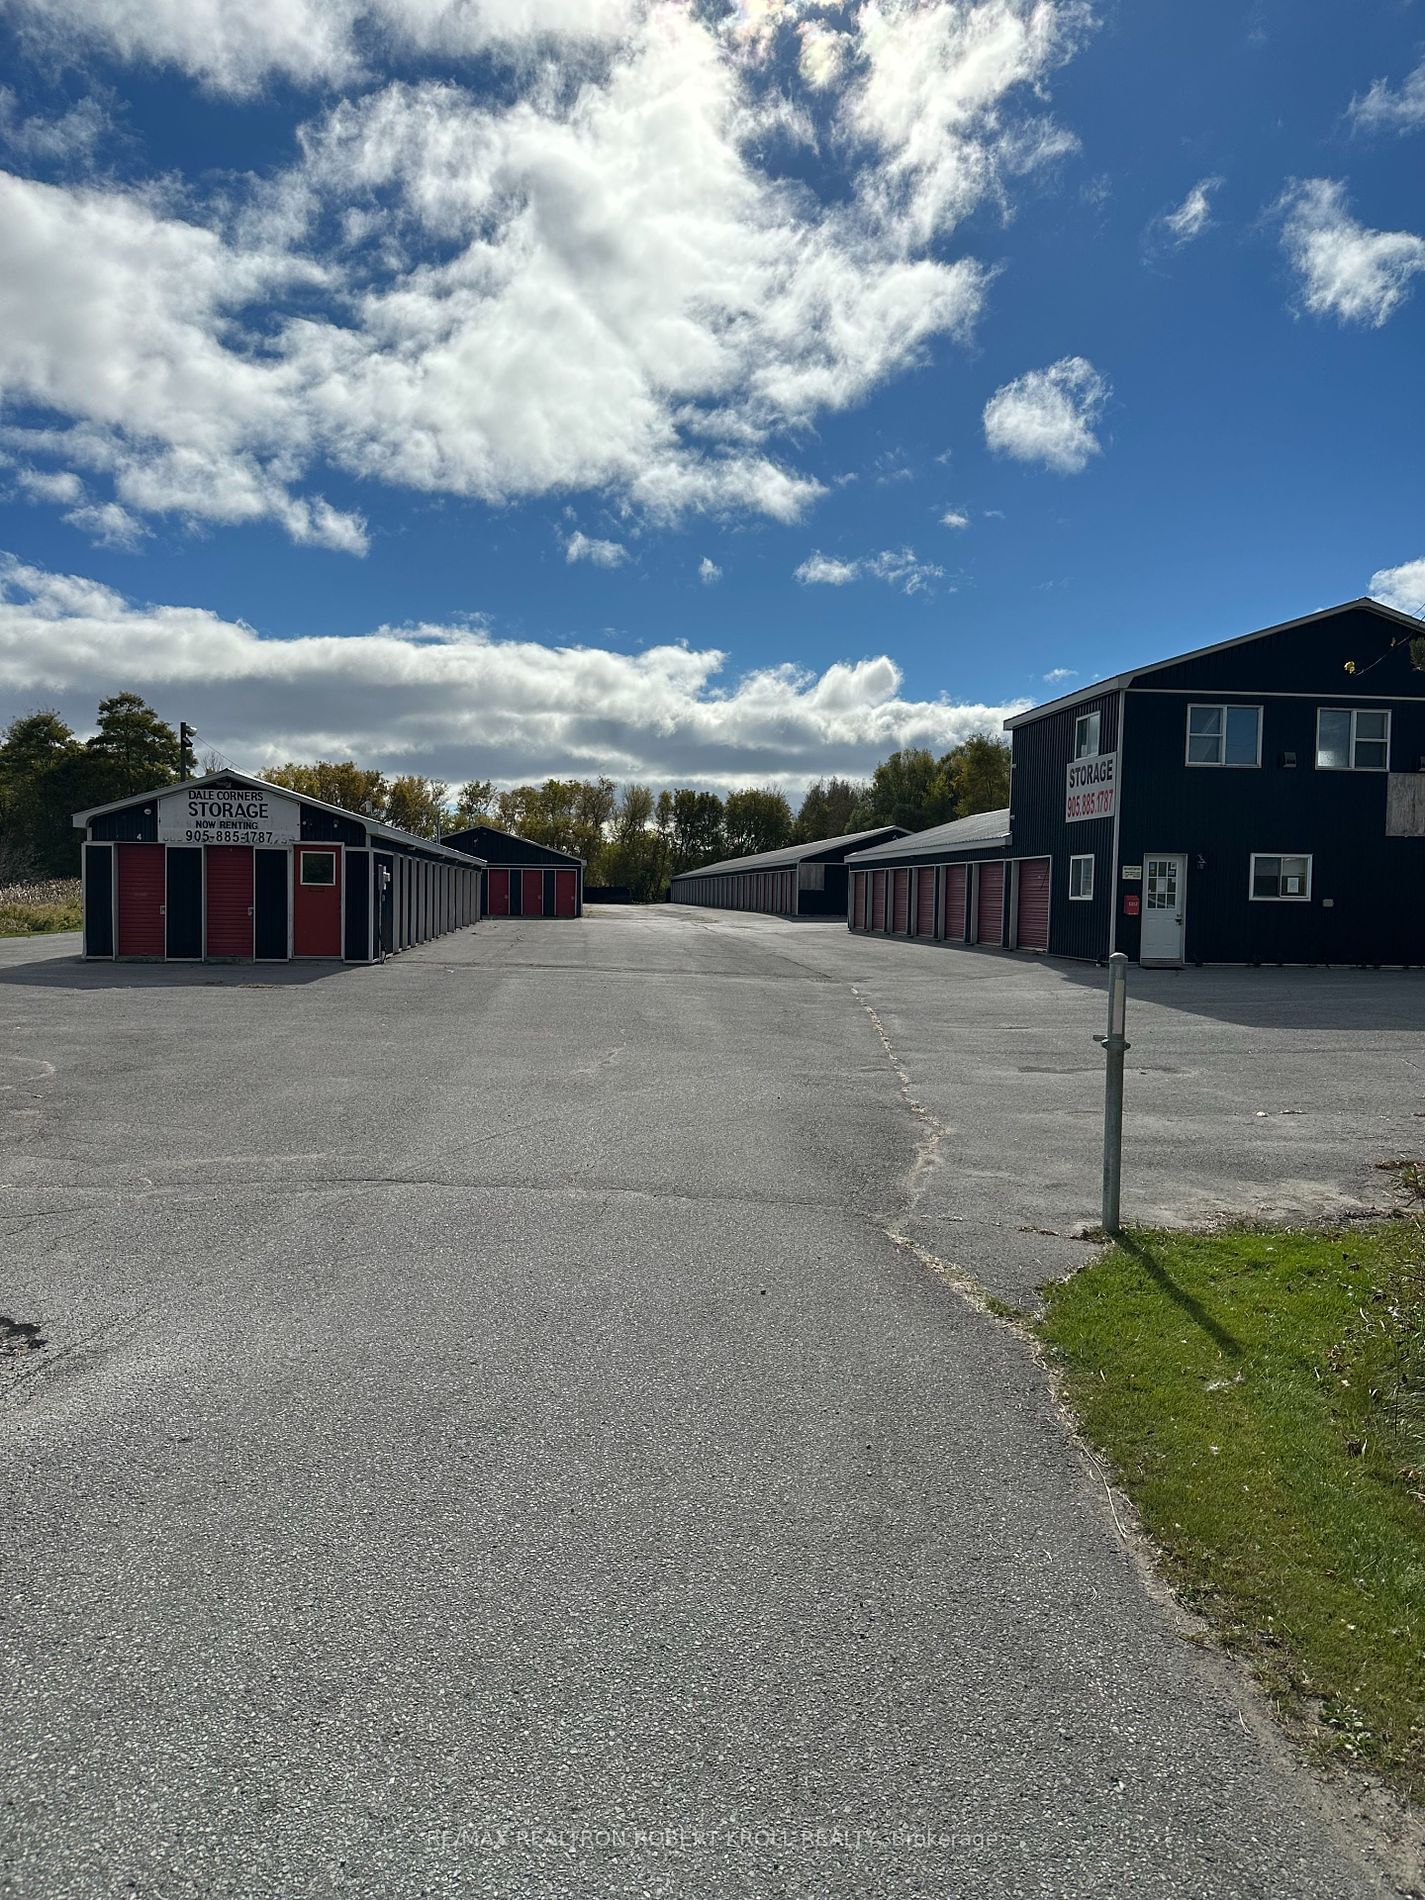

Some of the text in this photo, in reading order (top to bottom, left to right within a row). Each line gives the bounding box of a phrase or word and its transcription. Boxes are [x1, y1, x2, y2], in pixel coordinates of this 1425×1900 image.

[1069, 759, 1113, 789] STORAGE
[188, 790, 264, 802] DALE CORNERS
[1067, 789, 1114, 818] 905.885.1787
[188, 801, 269, 819] STORAGE
[195, 820, 258, 830] NOW RENTING
[185, 830, 273, 843] 905-885-1787
